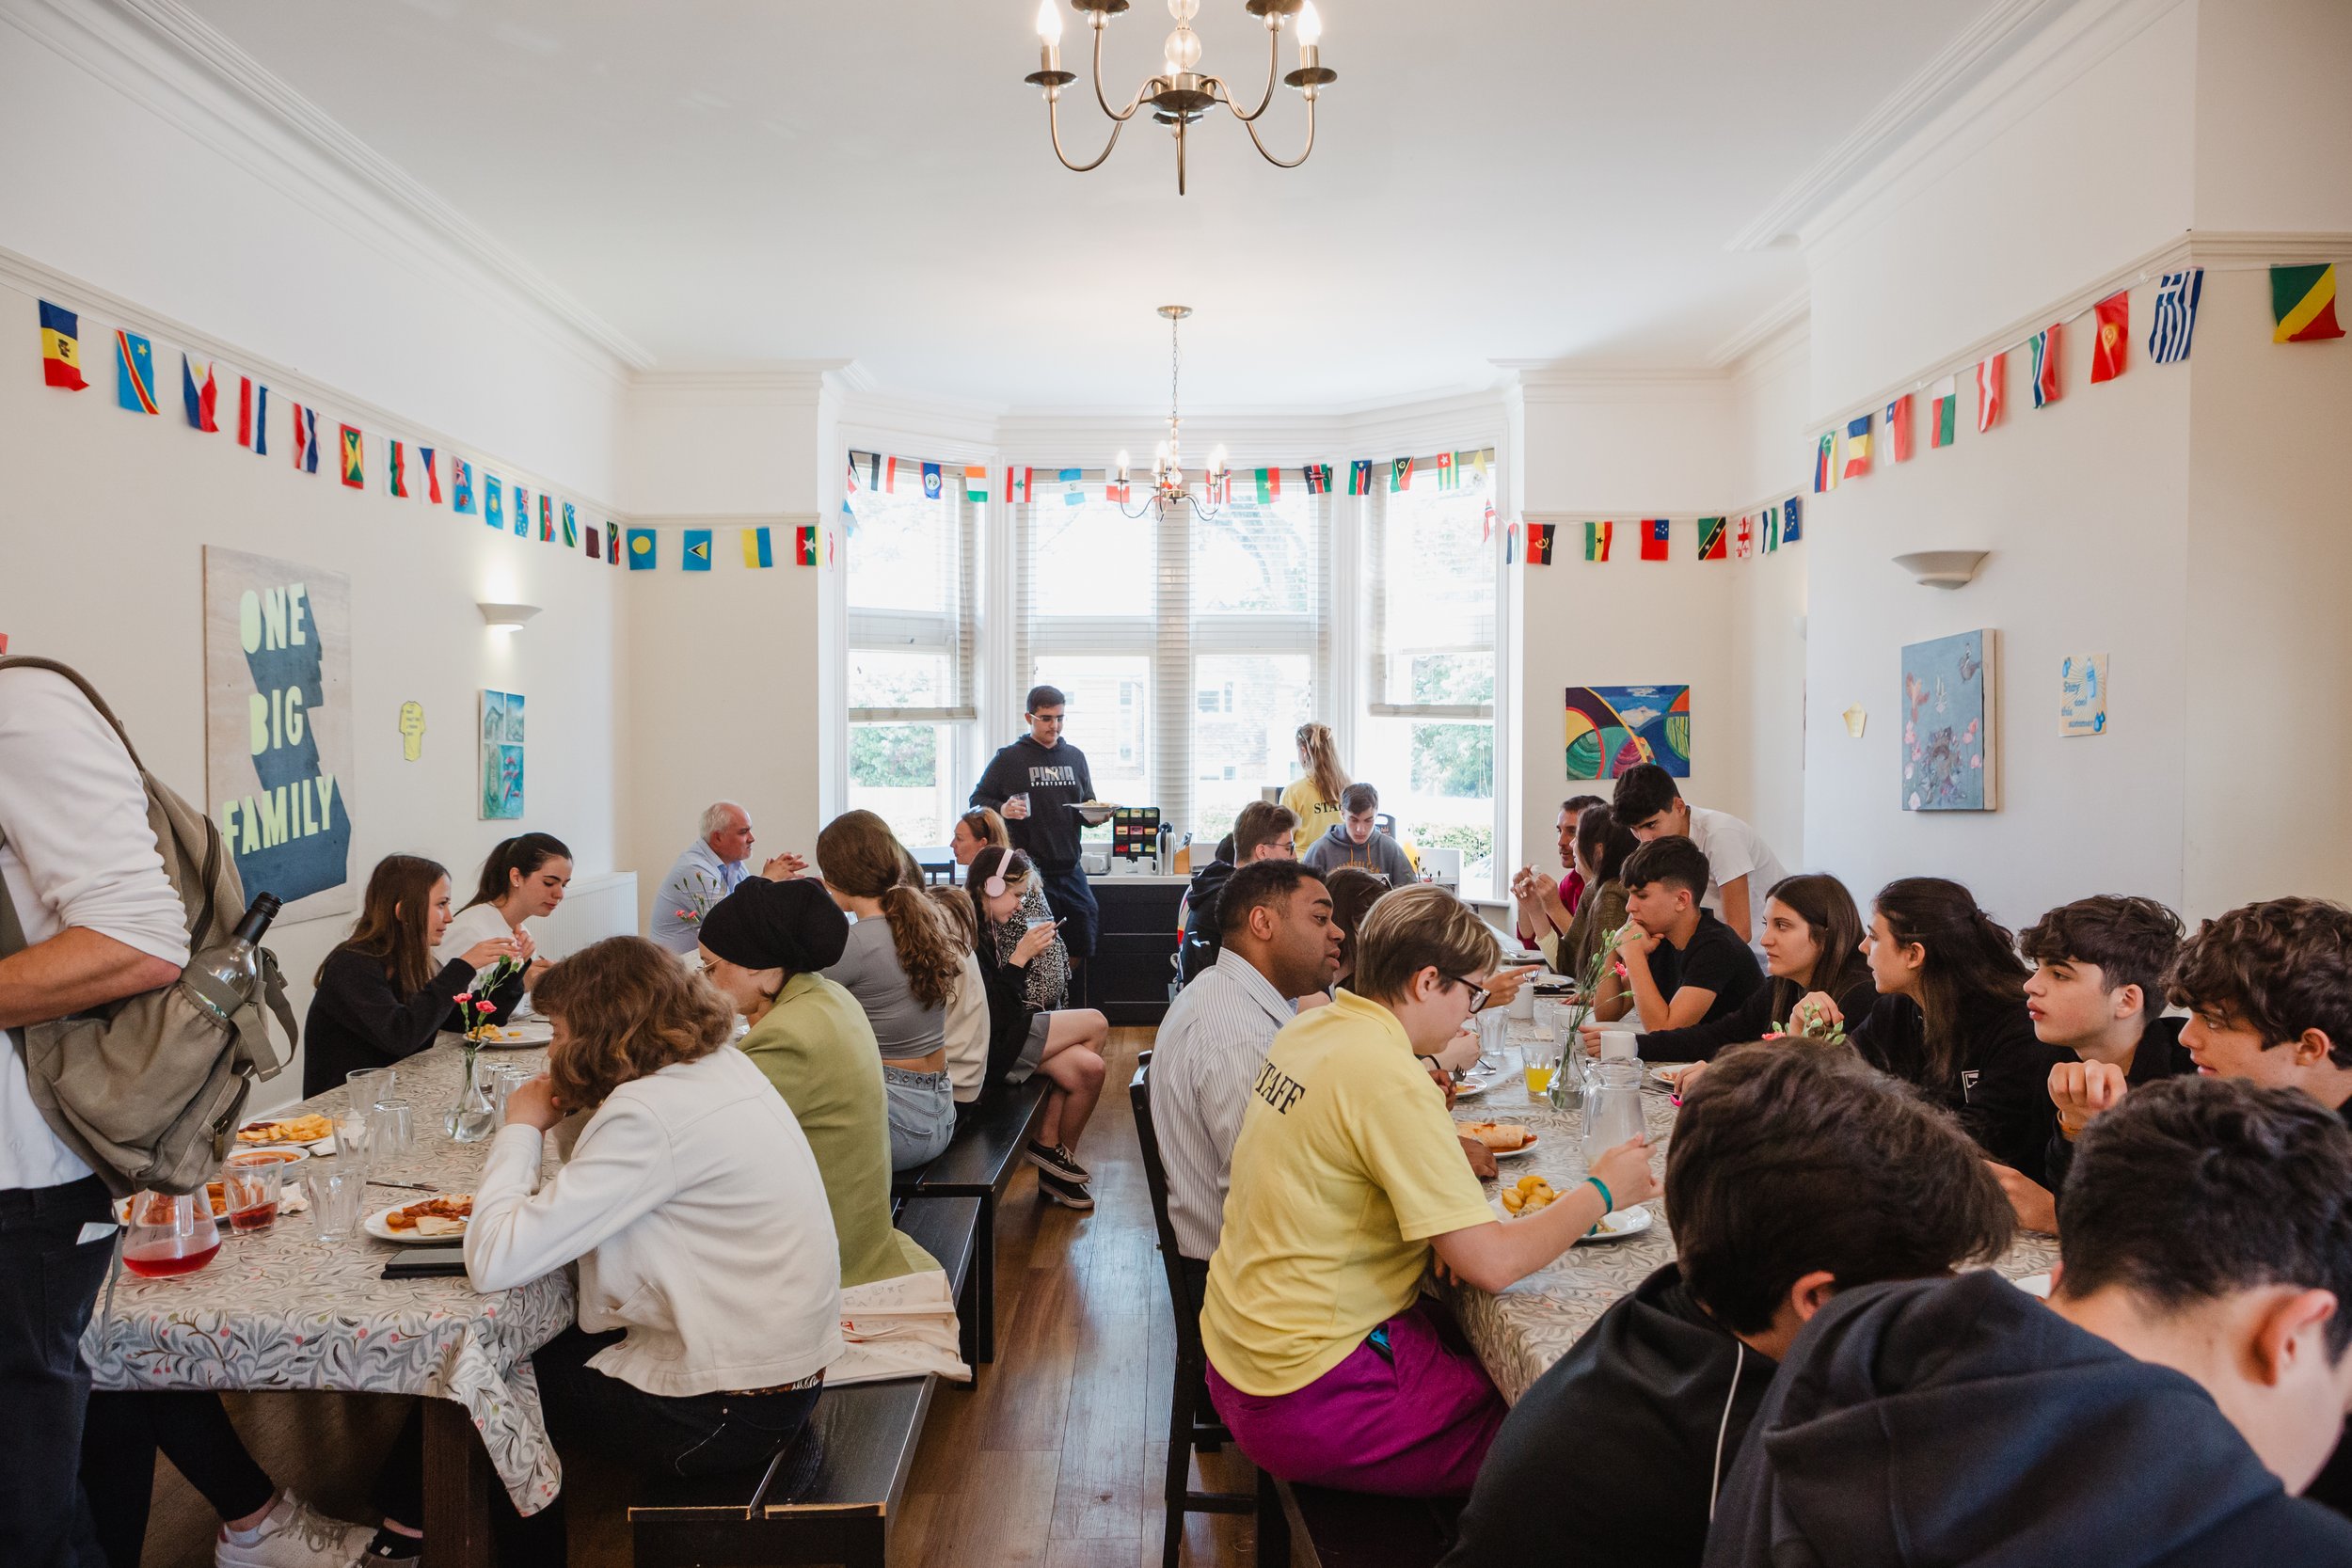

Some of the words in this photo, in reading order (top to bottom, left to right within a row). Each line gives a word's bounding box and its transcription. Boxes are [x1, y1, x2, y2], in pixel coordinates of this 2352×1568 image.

[239, 582, 306, 655] ONE
[248, 685, 304, 756] BIG
[2063, 680, 2080, 694] Stay
[222, 772, 334, 862] FAMILY
[1313, 801, 1342, 815] STA
